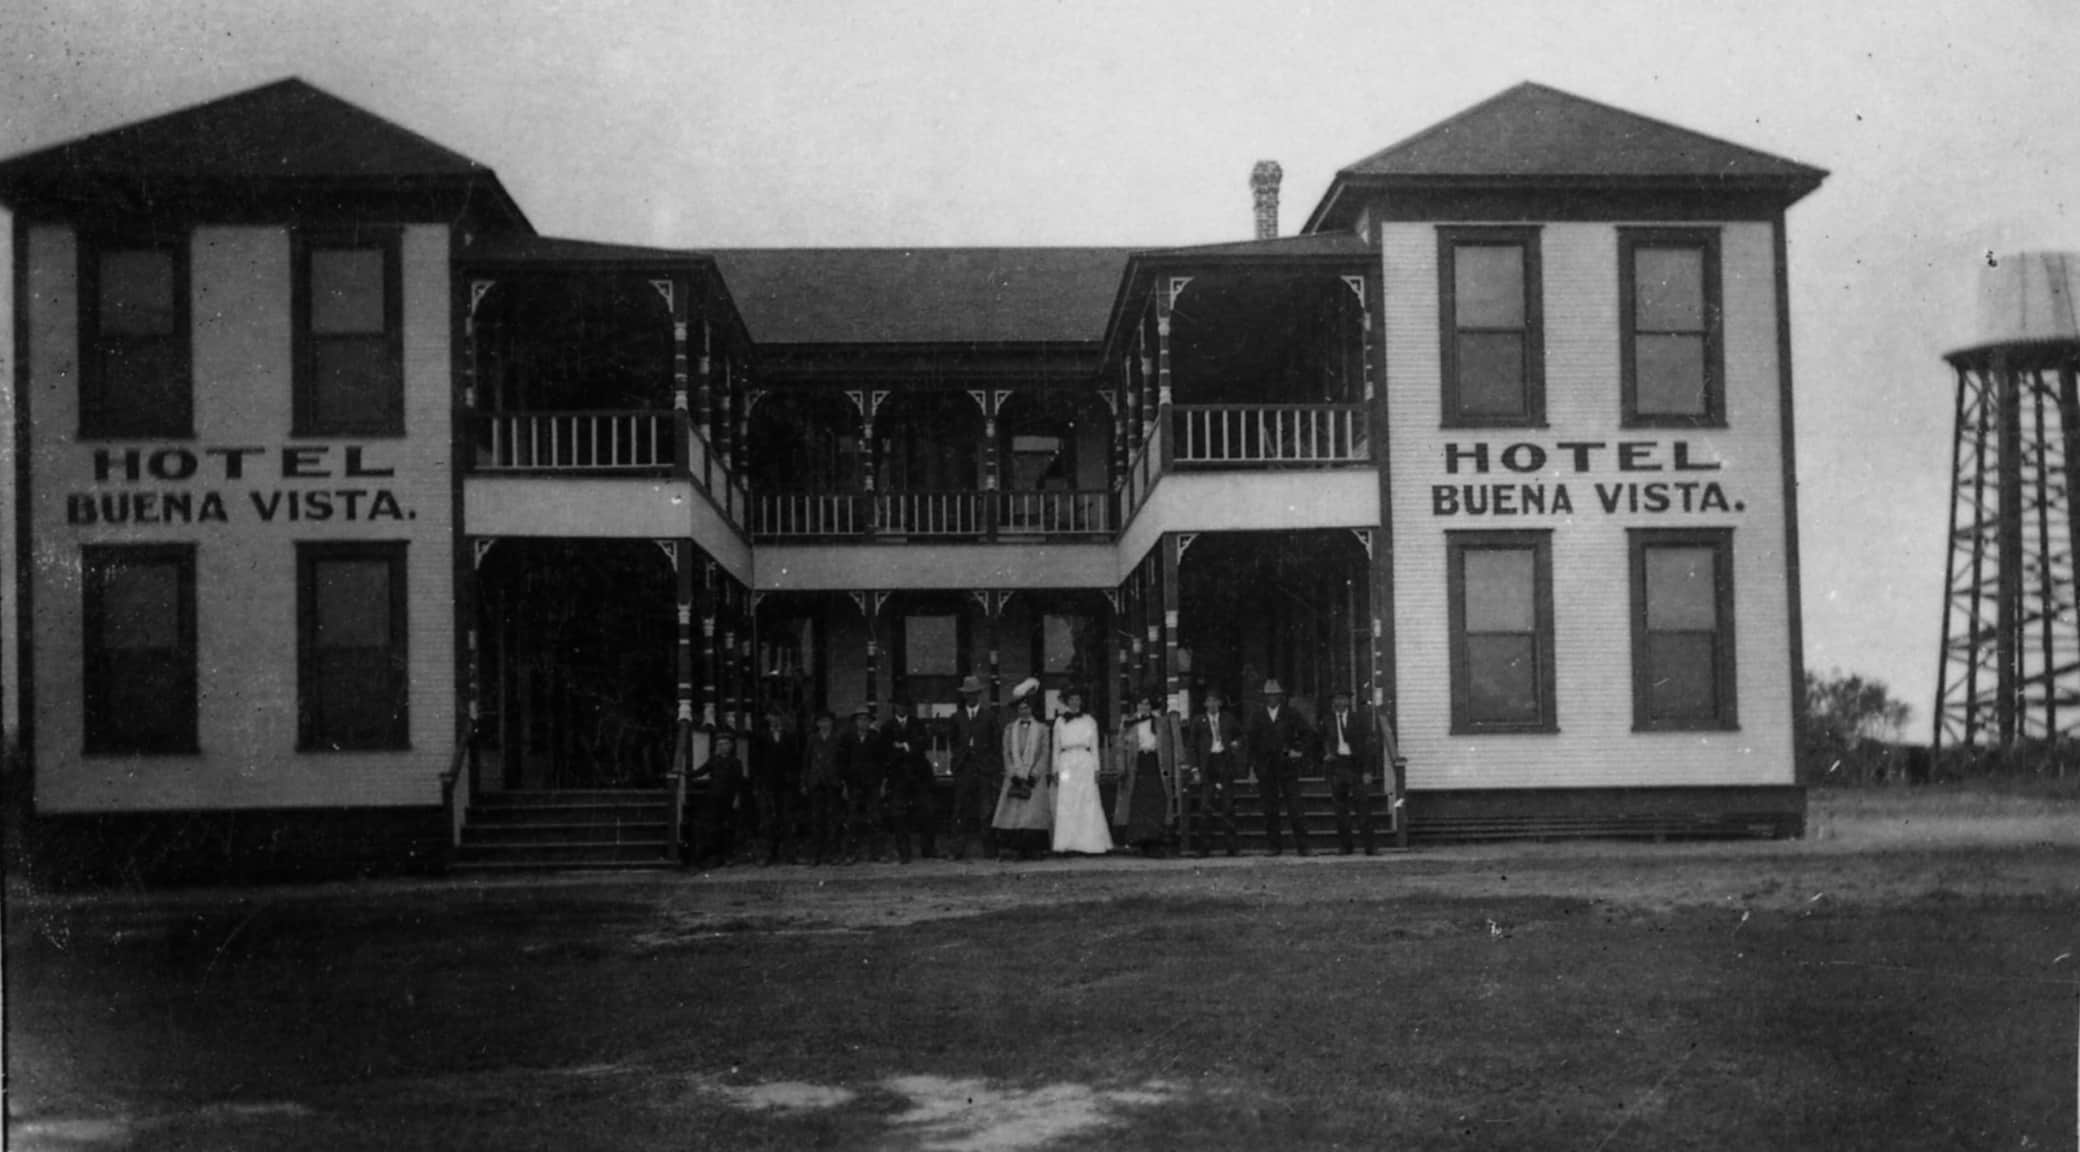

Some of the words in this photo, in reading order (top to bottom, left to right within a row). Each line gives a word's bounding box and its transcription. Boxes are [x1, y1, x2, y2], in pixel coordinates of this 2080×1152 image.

[93, 446, 395, 481] HOTEL
[1445, 441, 1721, 474] HOTEL
[66, 490, 229, 525] BUENA
[249, 490, 417, 522] VISTA.
[1431, 483, 1574, 516] BUENA
[1594, 482, 1746, 514] VISTA.
